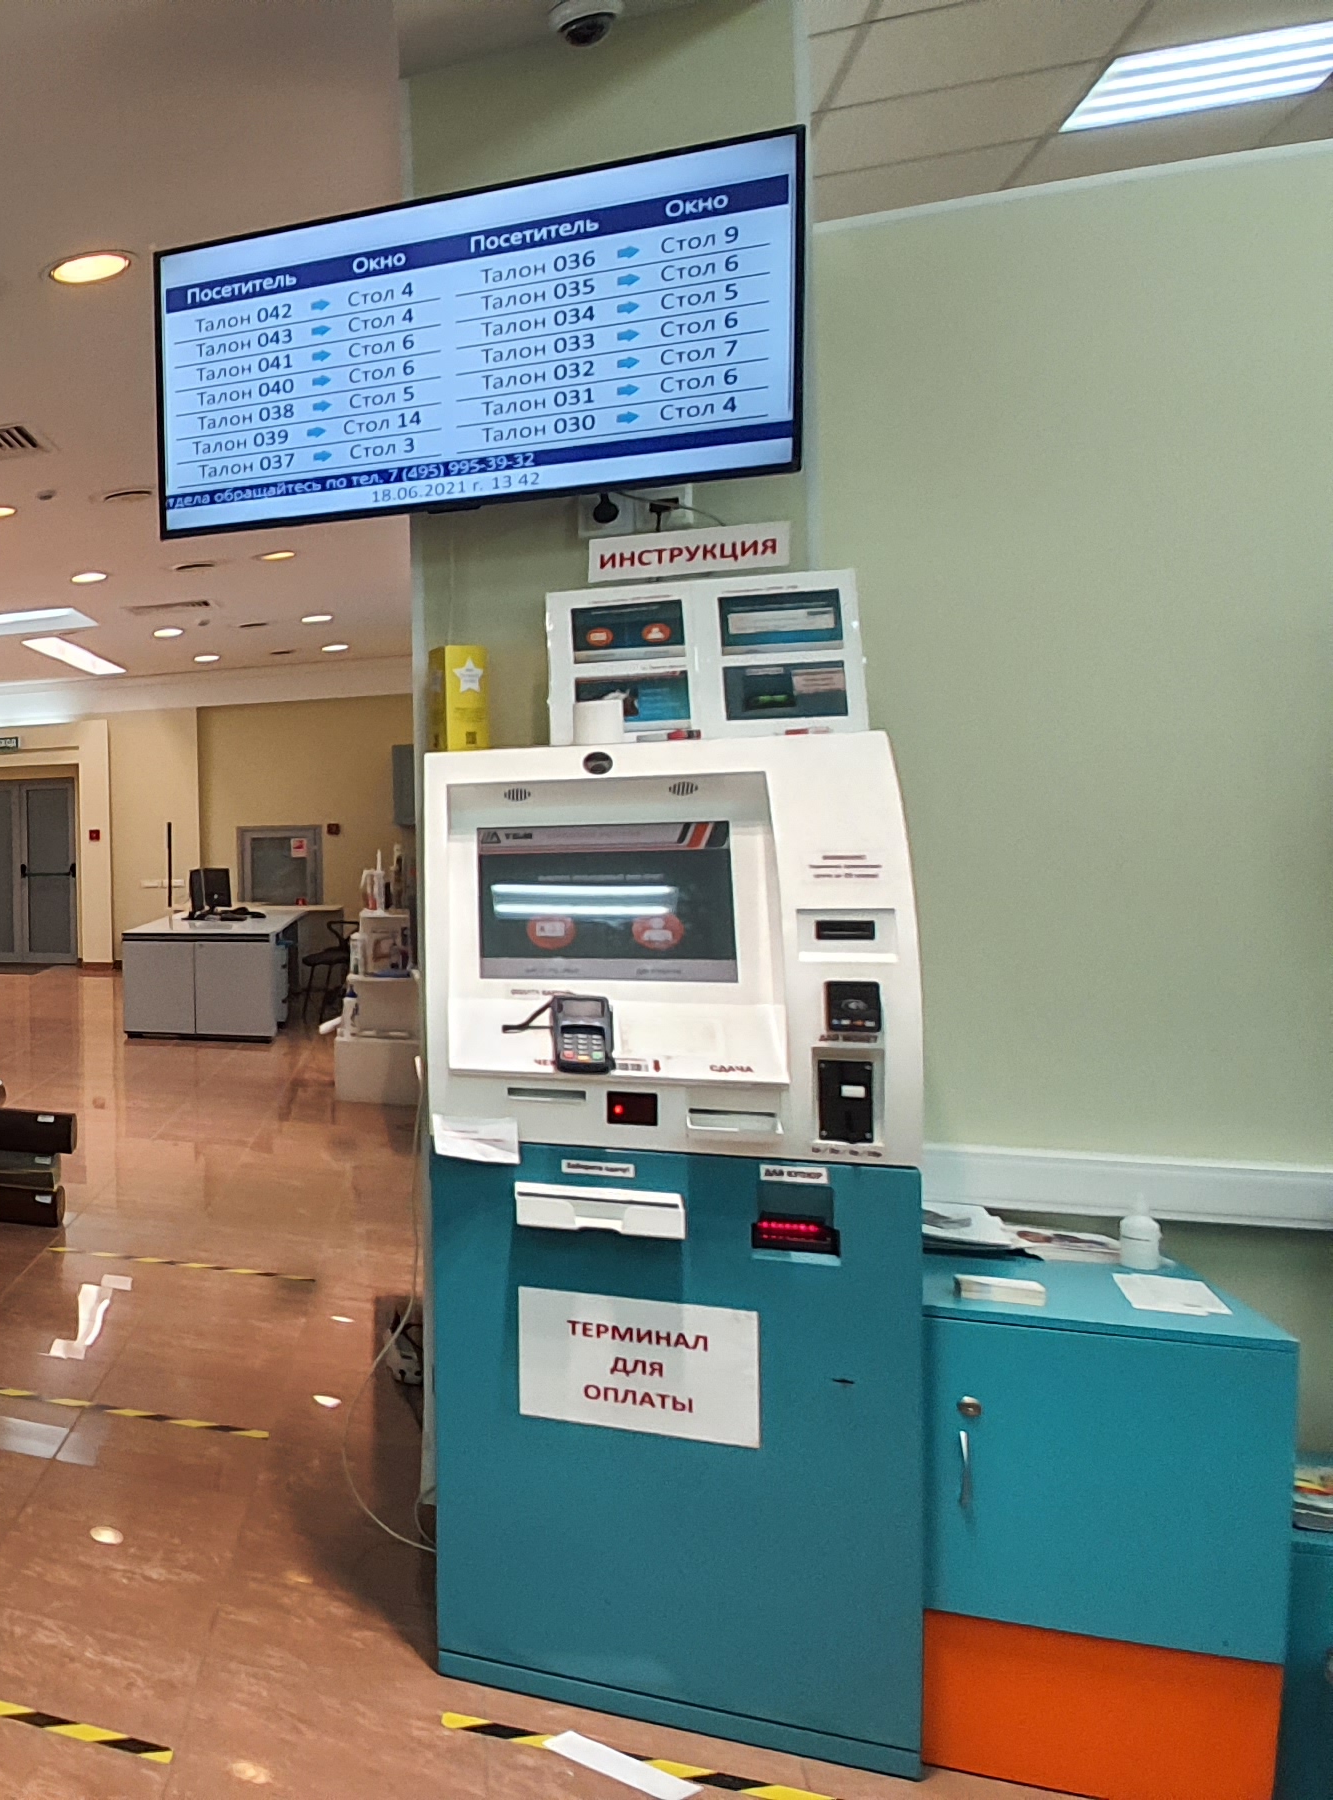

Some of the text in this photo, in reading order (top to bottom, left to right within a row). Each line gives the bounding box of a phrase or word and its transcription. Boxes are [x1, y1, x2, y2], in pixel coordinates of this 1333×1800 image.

[470, 194, 729, 253] Посетитель Окно
[187, 252, 406, 304] Посетитель Окно
[481, 226, 739, 284] Талон 036 Стол 9
[481, 255, 739, 311] Талон 035 Стол 6
[196, 282, 413, 333] Талон 042 Стол 4
[481, 283, 739, 337] Талон 034 Стол 5
[196, 308, 414, 358] Талон 043 Стол 4
[481, 312, 739, 364] Талон 033 Стол 6
[197, 334, 415, 382] Талон 041 Стол 6
[481, 340, 739, 390] Талон 032 Стол 7
[197, 360, 415, 406] Талон 040 Стол 6
[481, 368, 737, 417] Талон 031 Стол 6
[198, 386, 415, 431] Талон 038 Стол 5
[481, 396, 737, 443] Талон 030 Стол 4
[192, 410, 421, 456] Талон 039 Стол 14
[198, 437, 415, 480] Талон 037 Стол 3
[214, 481, 322, 504] обращайтесь
[326, 477, 347, 489] по
[352, 473, 383, 486] тел.
[389, 469, 398, 482] 7
[402, 464, 444, 482] (495)
[448, 453, 535, 476] 995-39-32
[372, 472, 540, 503] 18.06.2021 г. 13 42
[599, 537, 778, 569] ИНСТРУКЦИЯ
[709, 1064, 754, 1073] СДАЧА
[567, 1320, 709, 1351] ТЕРМИНАЛ
[610, 1357, 663, 1377] ДЛЯ
[584, 1384, 693, 1413] ОПЛАТЫ
